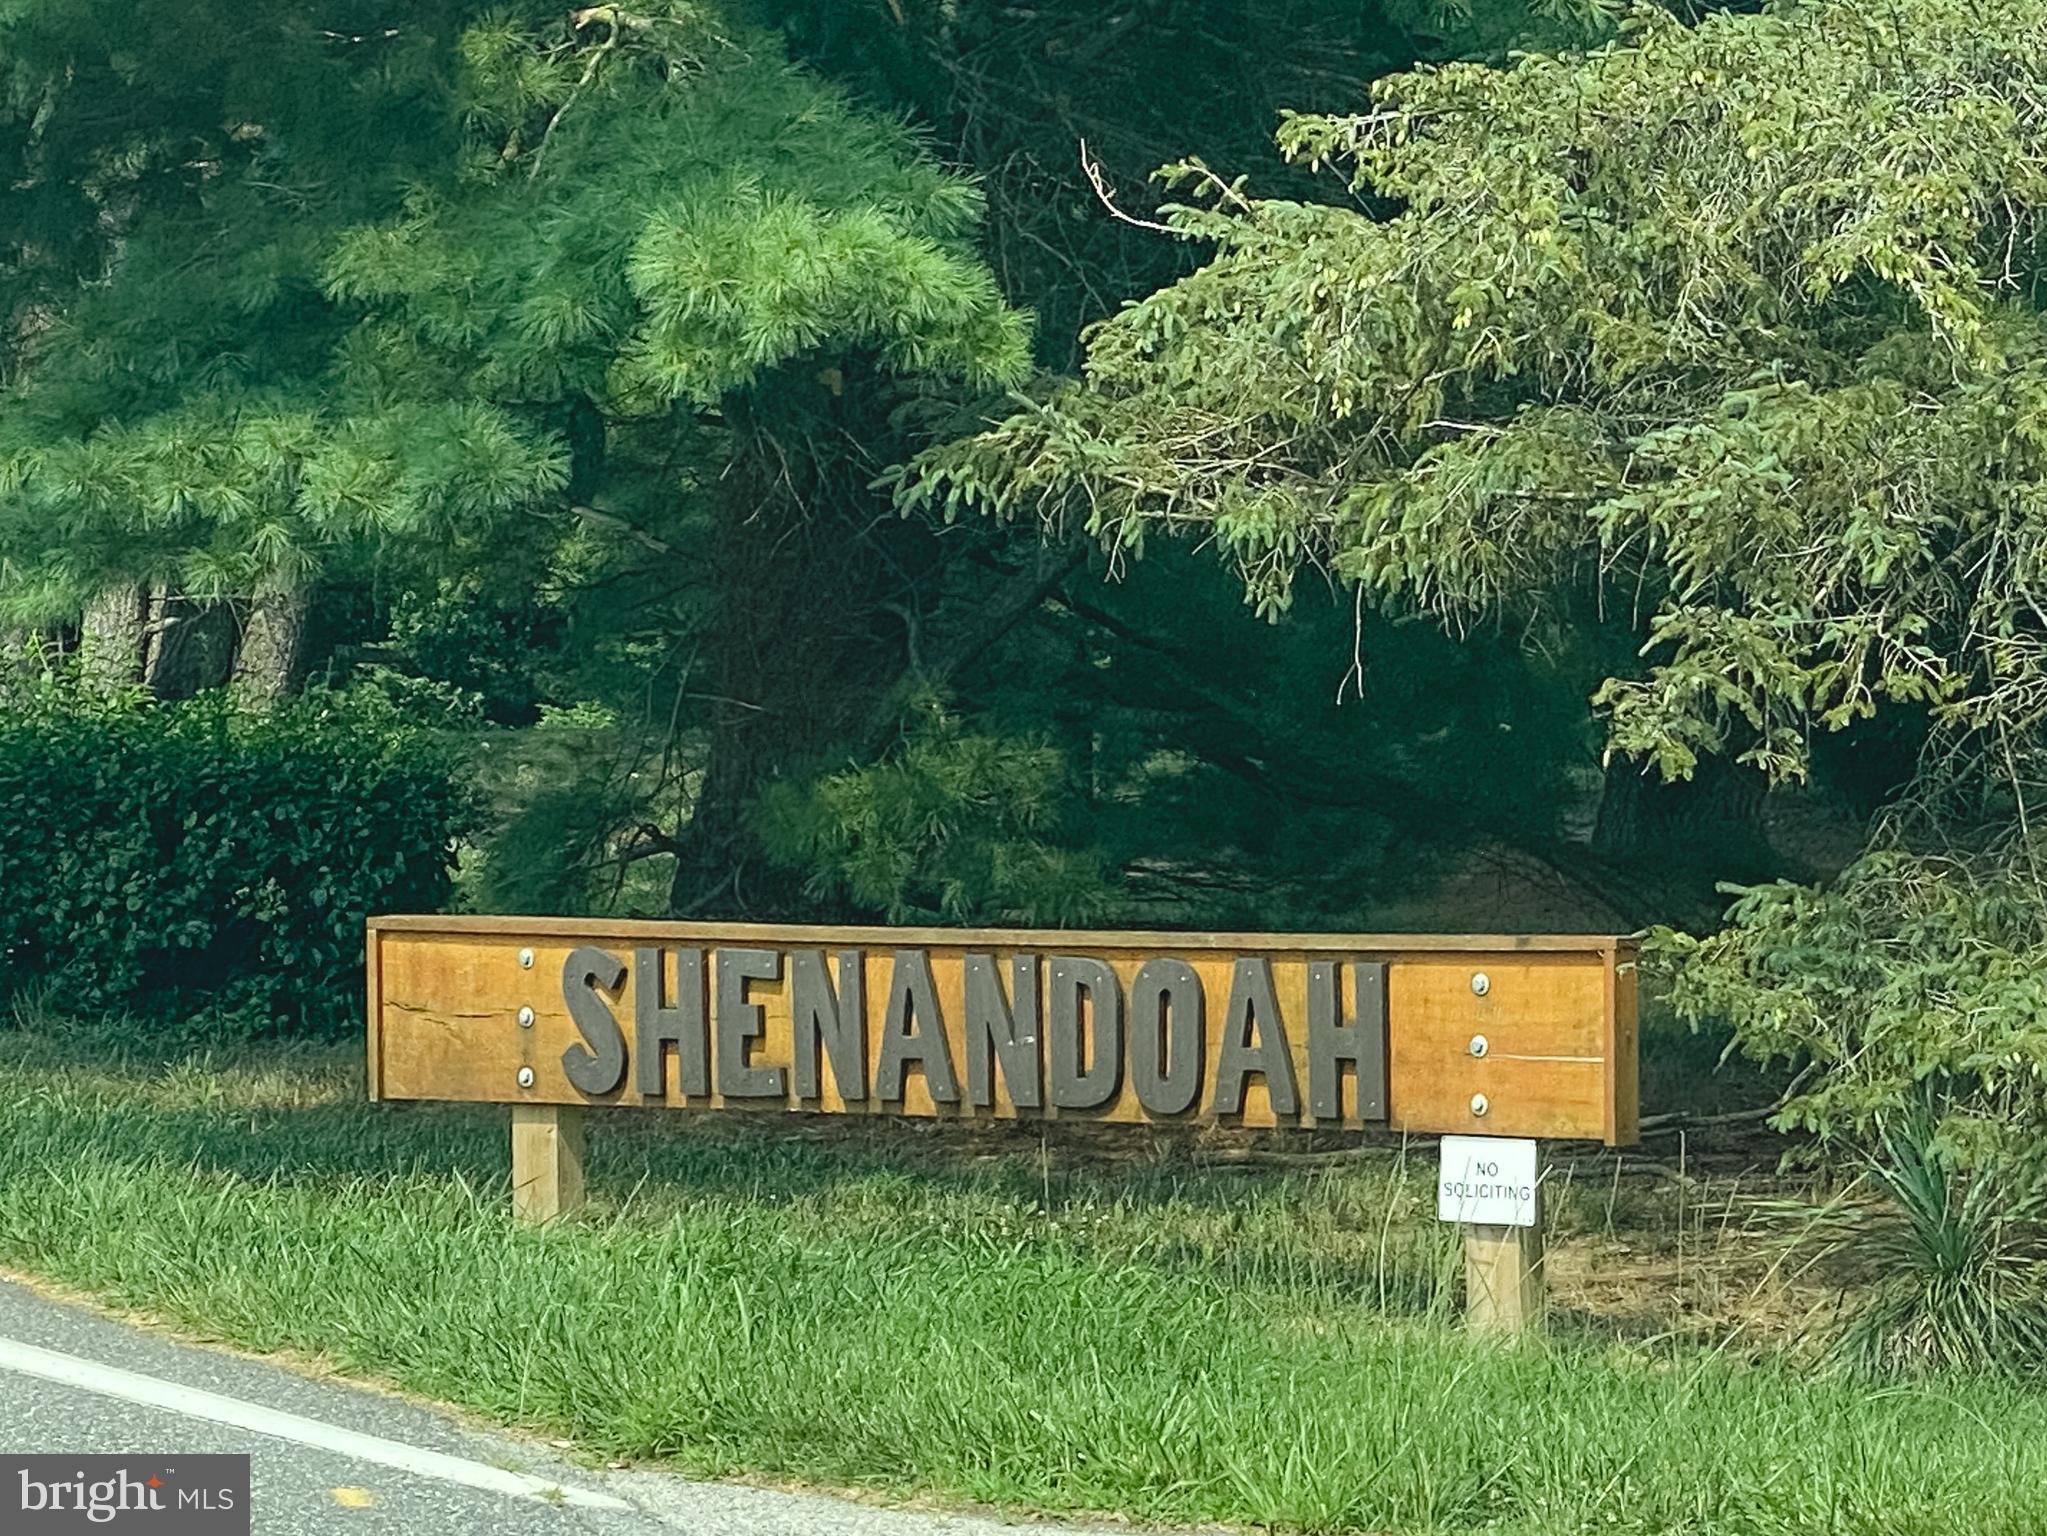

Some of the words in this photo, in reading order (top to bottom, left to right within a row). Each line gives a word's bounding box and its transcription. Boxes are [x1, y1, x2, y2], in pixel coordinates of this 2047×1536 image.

[561, 946, 1389, 1121] SHENANDOAH
[1476, 1162, 1498, 1177] NO
[1444, 1182, 1530, 1201] SOLICITING
